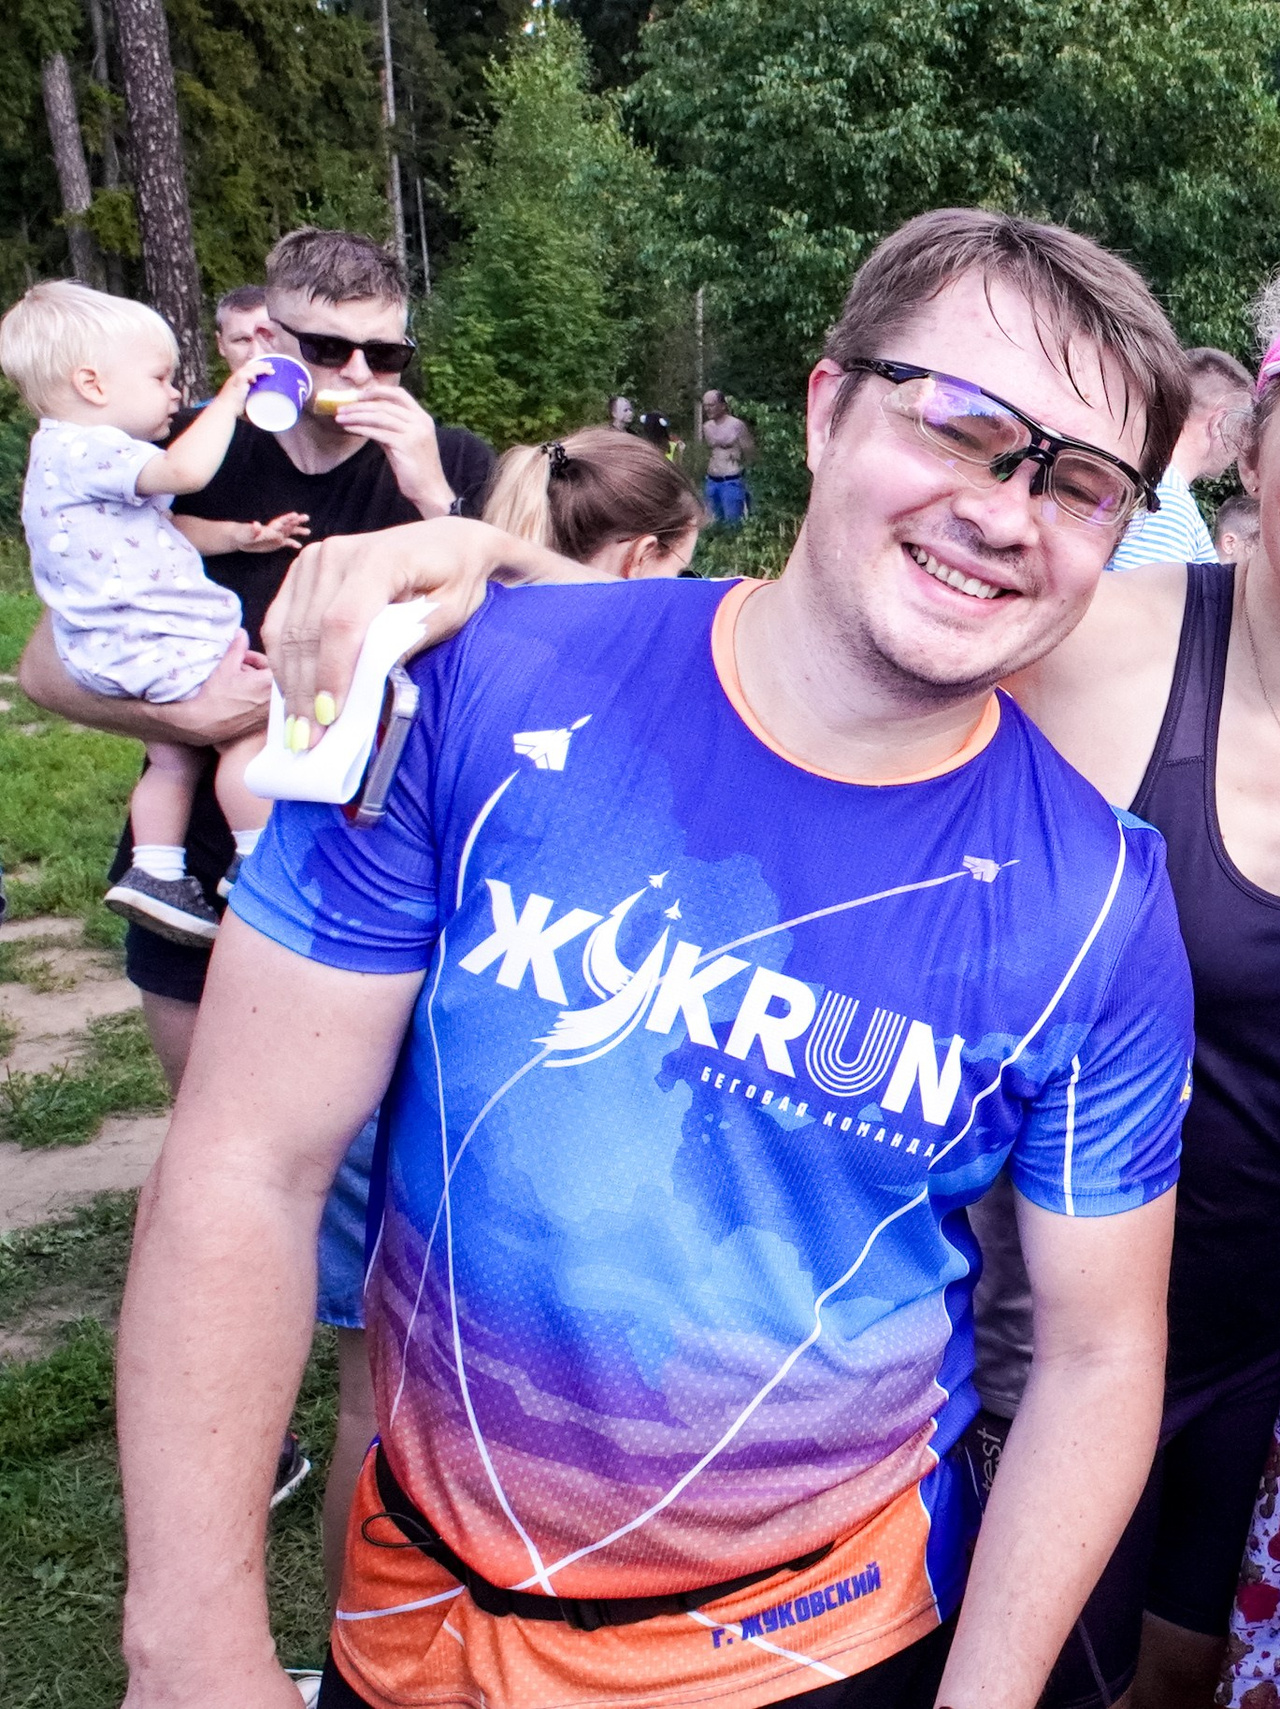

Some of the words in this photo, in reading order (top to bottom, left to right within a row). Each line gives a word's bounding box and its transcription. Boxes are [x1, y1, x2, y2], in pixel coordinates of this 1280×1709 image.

[700, 1066, 809, 1118] БЕГОВАЯ
[822, 1110, 936, 1158] КОМАНДА
[740, 1560, 882, 1641] ЖУКОВСКИЙ
